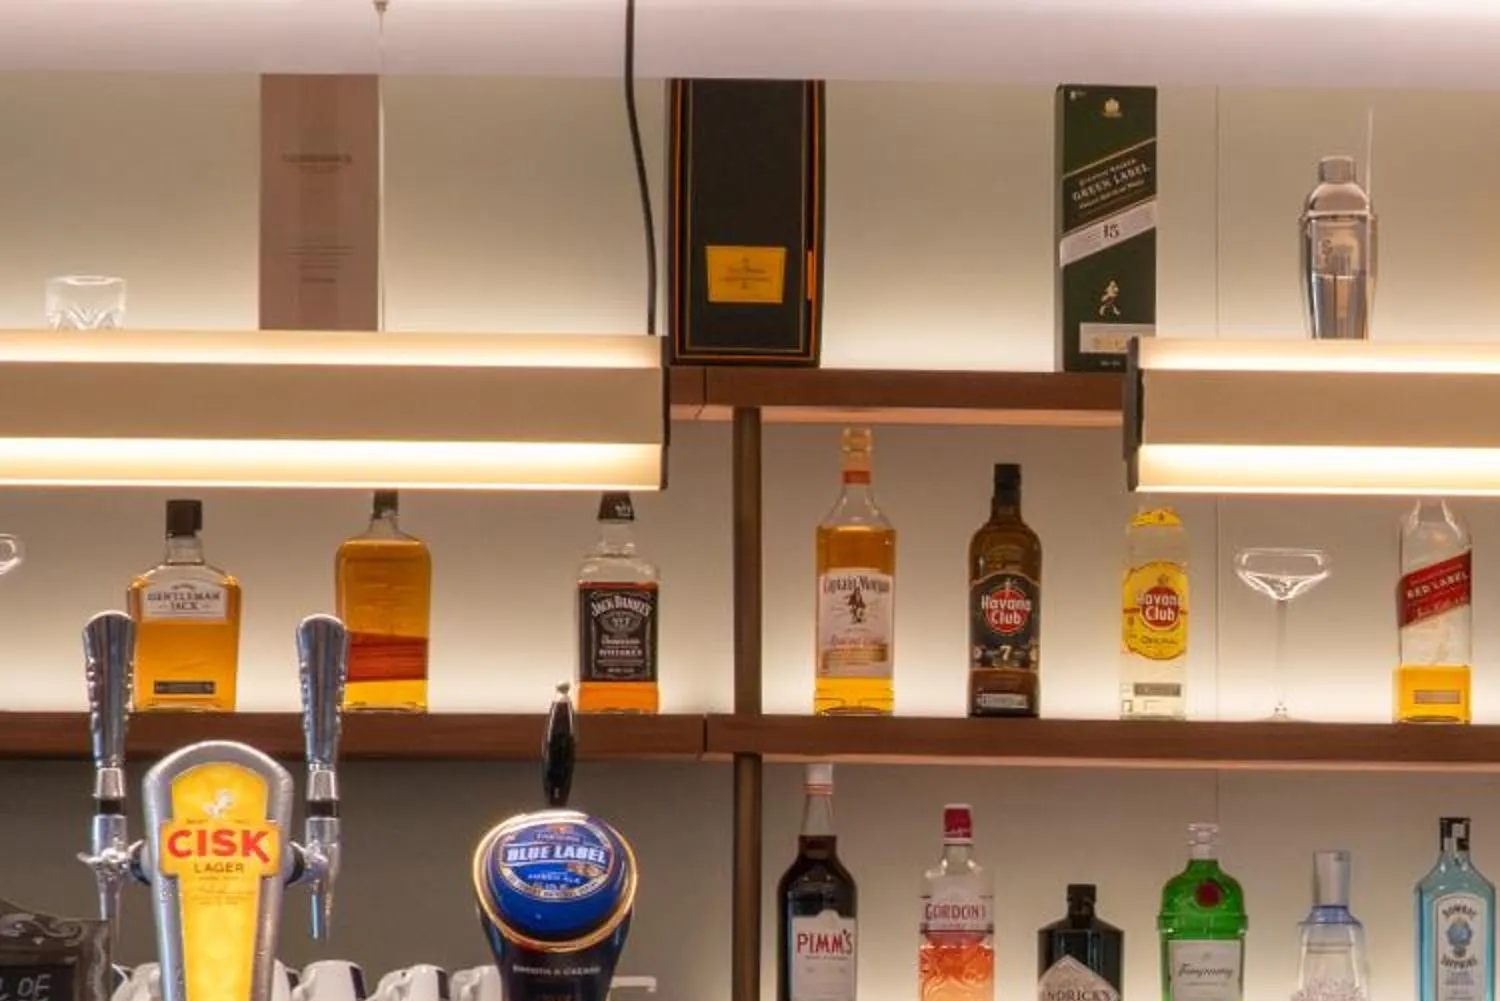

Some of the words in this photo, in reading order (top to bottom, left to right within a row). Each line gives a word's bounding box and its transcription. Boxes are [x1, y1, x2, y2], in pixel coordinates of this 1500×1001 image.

[1072, 181, 1112, 202] GREEN
[1113, 162, 1149, 185] LABEL
[147, 590, 220, 601] GENTLEMAN
[981, 594, 1032, 611] Havana
[591, 599, 615, 617] JACK
[1145, 605, 1176, 621] Club
[991, 610, 1022, 625] Club
[1000, 645, 1012, 660] 7
[167, 828, 271, 864] CISK
[507, 845, 550, 861] BLUE
[554, 844, 606, 863] LABEL
[194, 862, 245, 874] LAGER
[796, 928, 853, 954] PIMM'S
